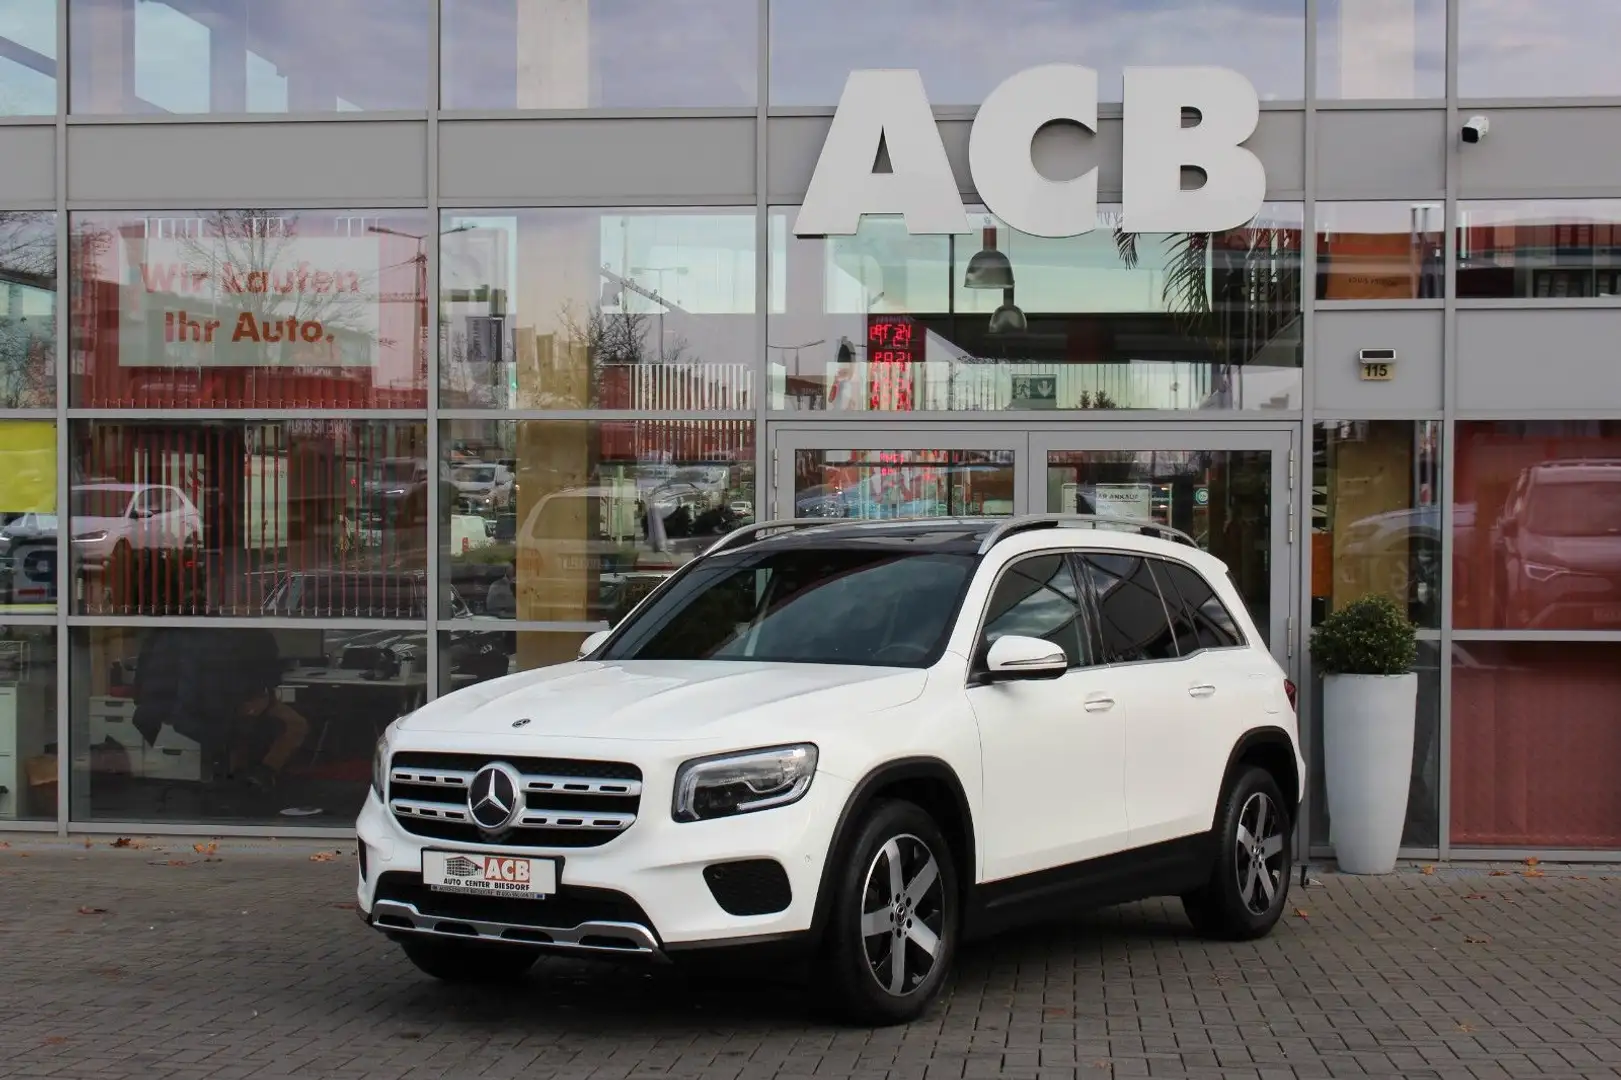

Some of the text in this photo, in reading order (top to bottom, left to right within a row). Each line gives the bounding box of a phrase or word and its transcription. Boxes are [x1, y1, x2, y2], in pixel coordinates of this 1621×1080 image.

[793, 63, 1266, 237] ACB
[140, 260, 361, 294] Wir kaufen
[165, 310, 336, 344] Ihr Auto.
[1365, 364, 1388, 377] 115
[443, 877, 530, 891] AUTO CENTER BIESDORF
[485, 858, 530, 882] ACB
